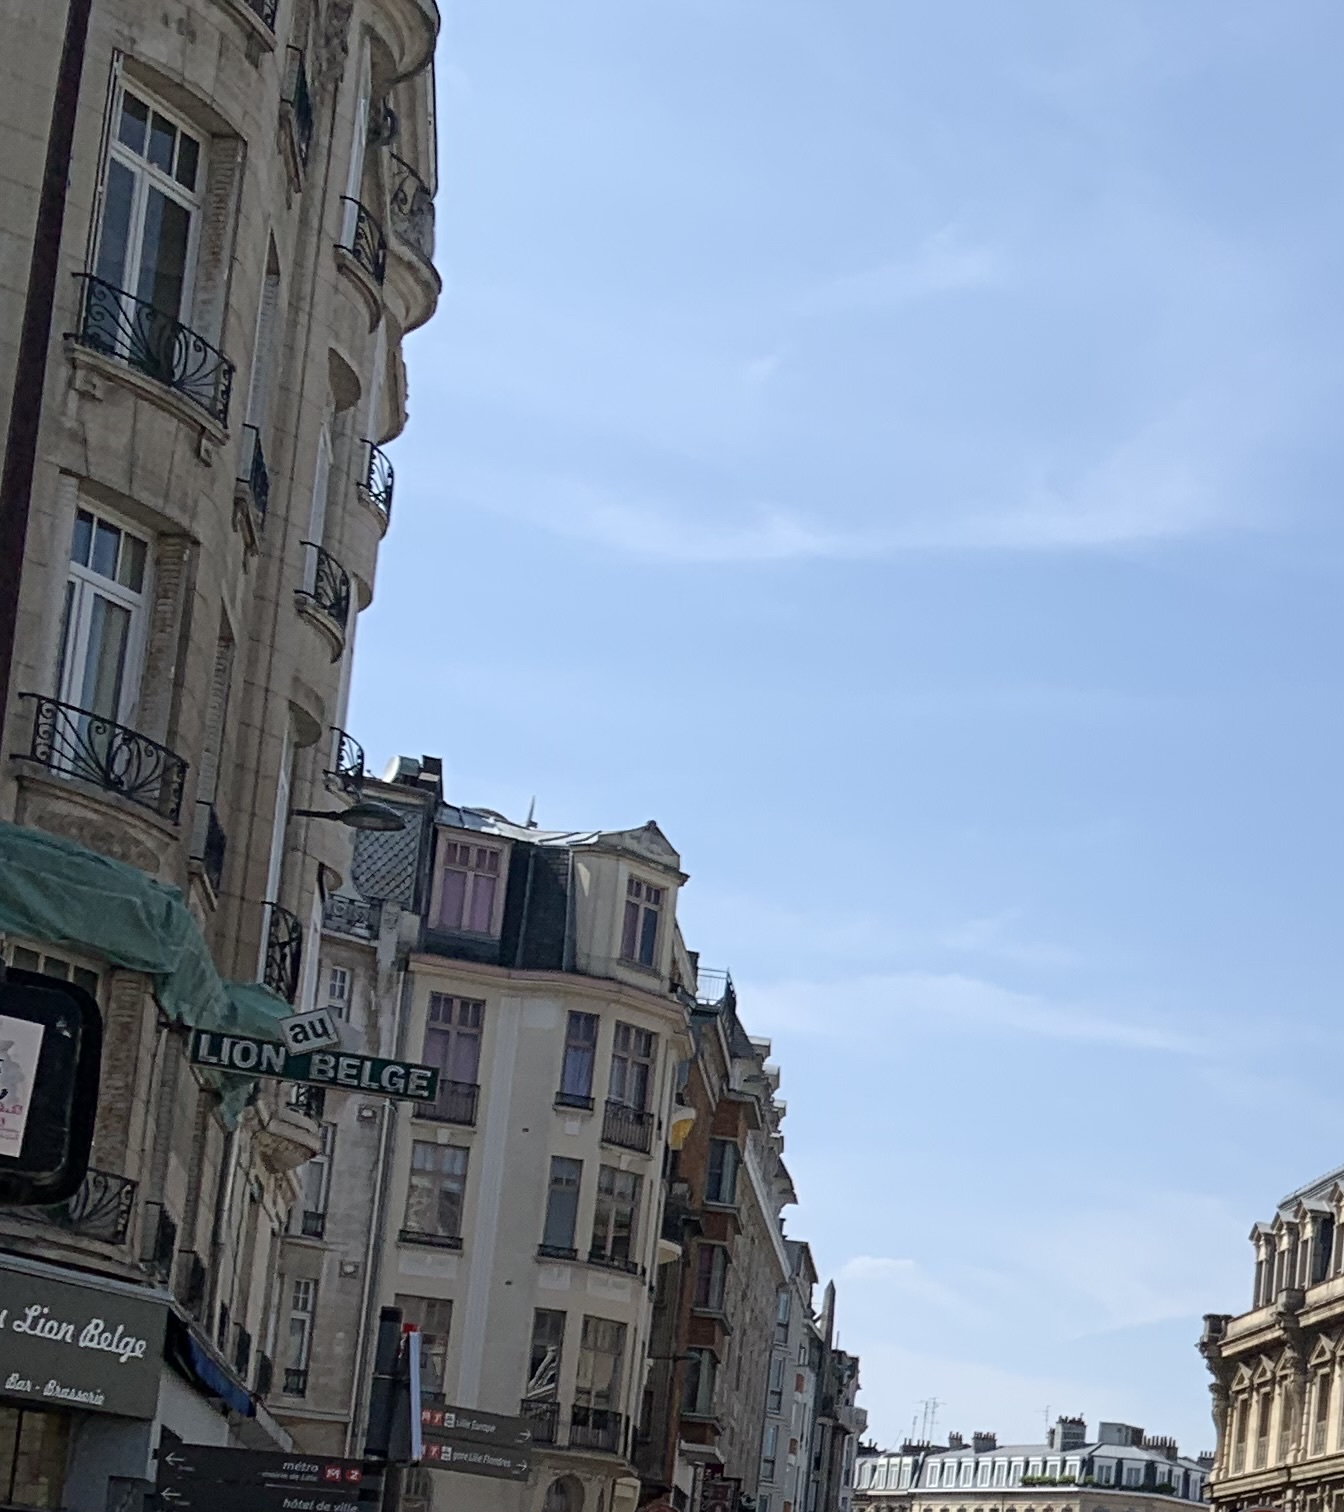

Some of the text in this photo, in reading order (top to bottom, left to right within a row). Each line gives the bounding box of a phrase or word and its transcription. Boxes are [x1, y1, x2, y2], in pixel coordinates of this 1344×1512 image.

[289, 1017, 332, 1044] au
[197, 1032, 433, 1098] LION BELGE
[13, 1304, 75, 1343] Lion
[79, 1317, 147, 1363] Belge
[5, 1372, 32, 1392] Bar
[282, 1460, 319, 1473] métro
